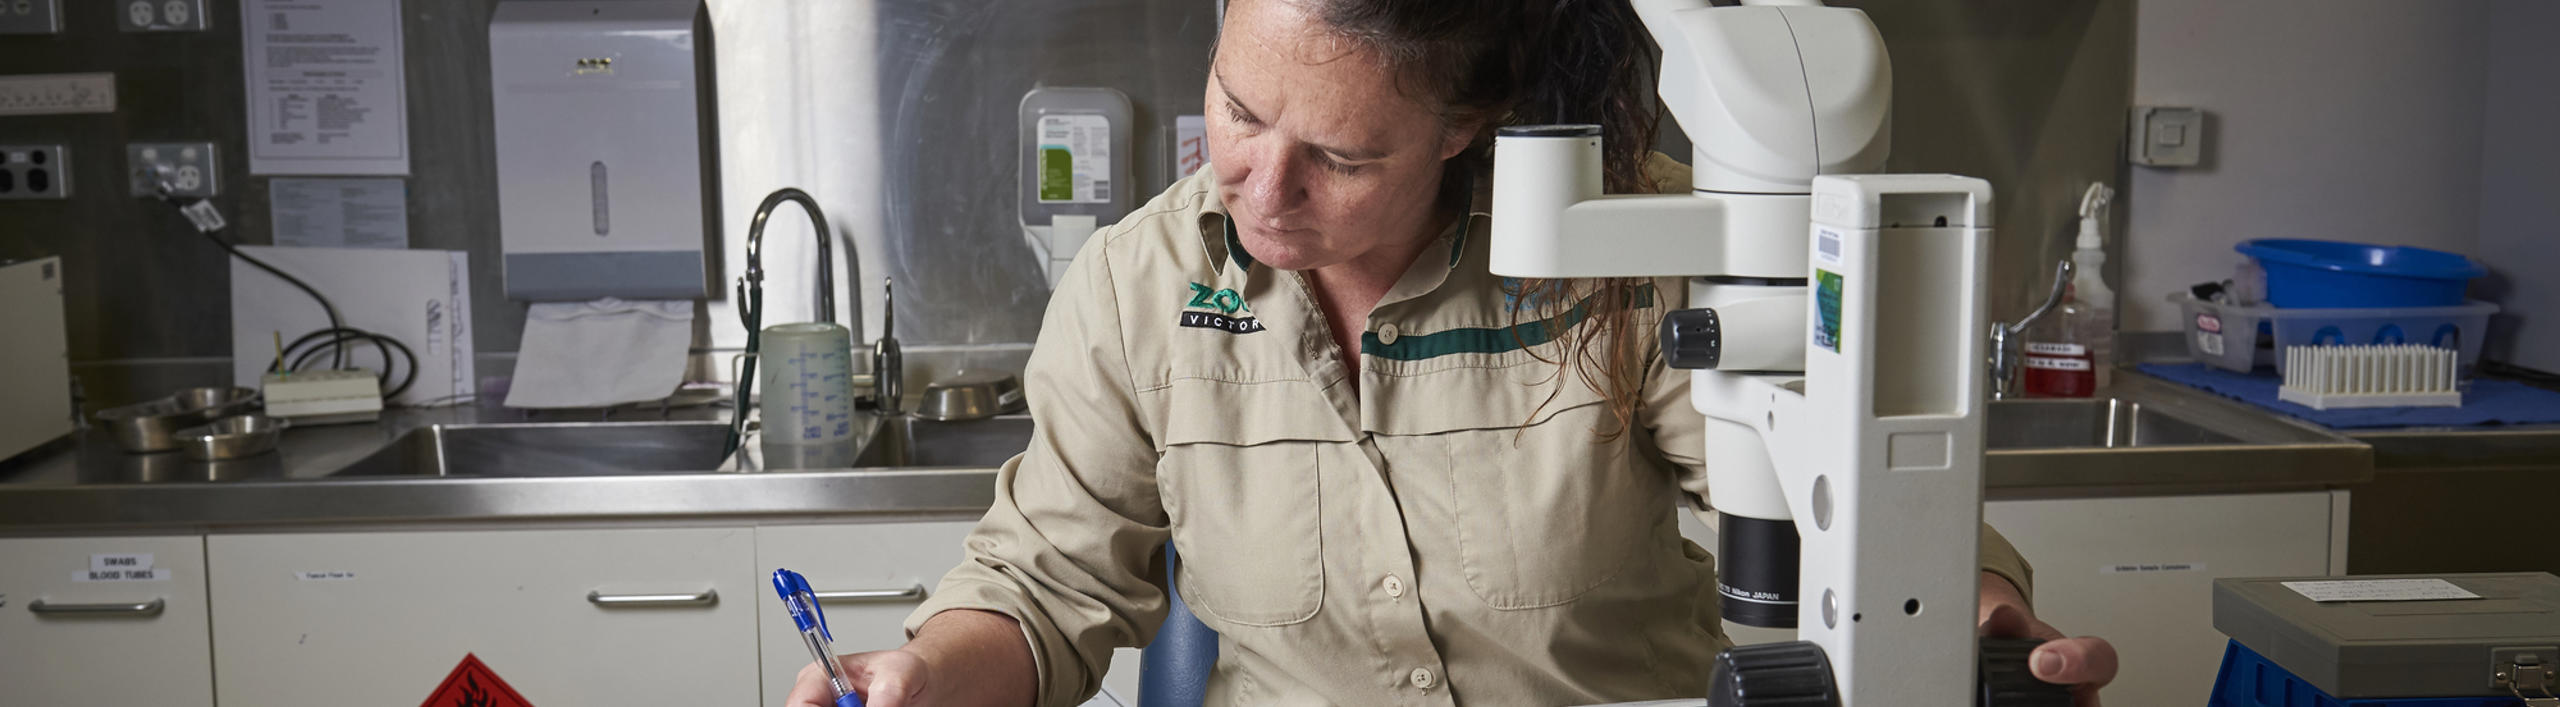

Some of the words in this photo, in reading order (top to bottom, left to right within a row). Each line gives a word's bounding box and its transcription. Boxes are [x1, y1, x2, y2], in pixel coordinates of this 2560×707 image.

[1190, 315, 1259, 331] VICTOR
[103, 557, 137, 566] SWABS
[88, 571, 120, 580] BLOOD
[125, 570, 153, 579] TUBES
[1752, 591, 1780, 601] JAPAN
